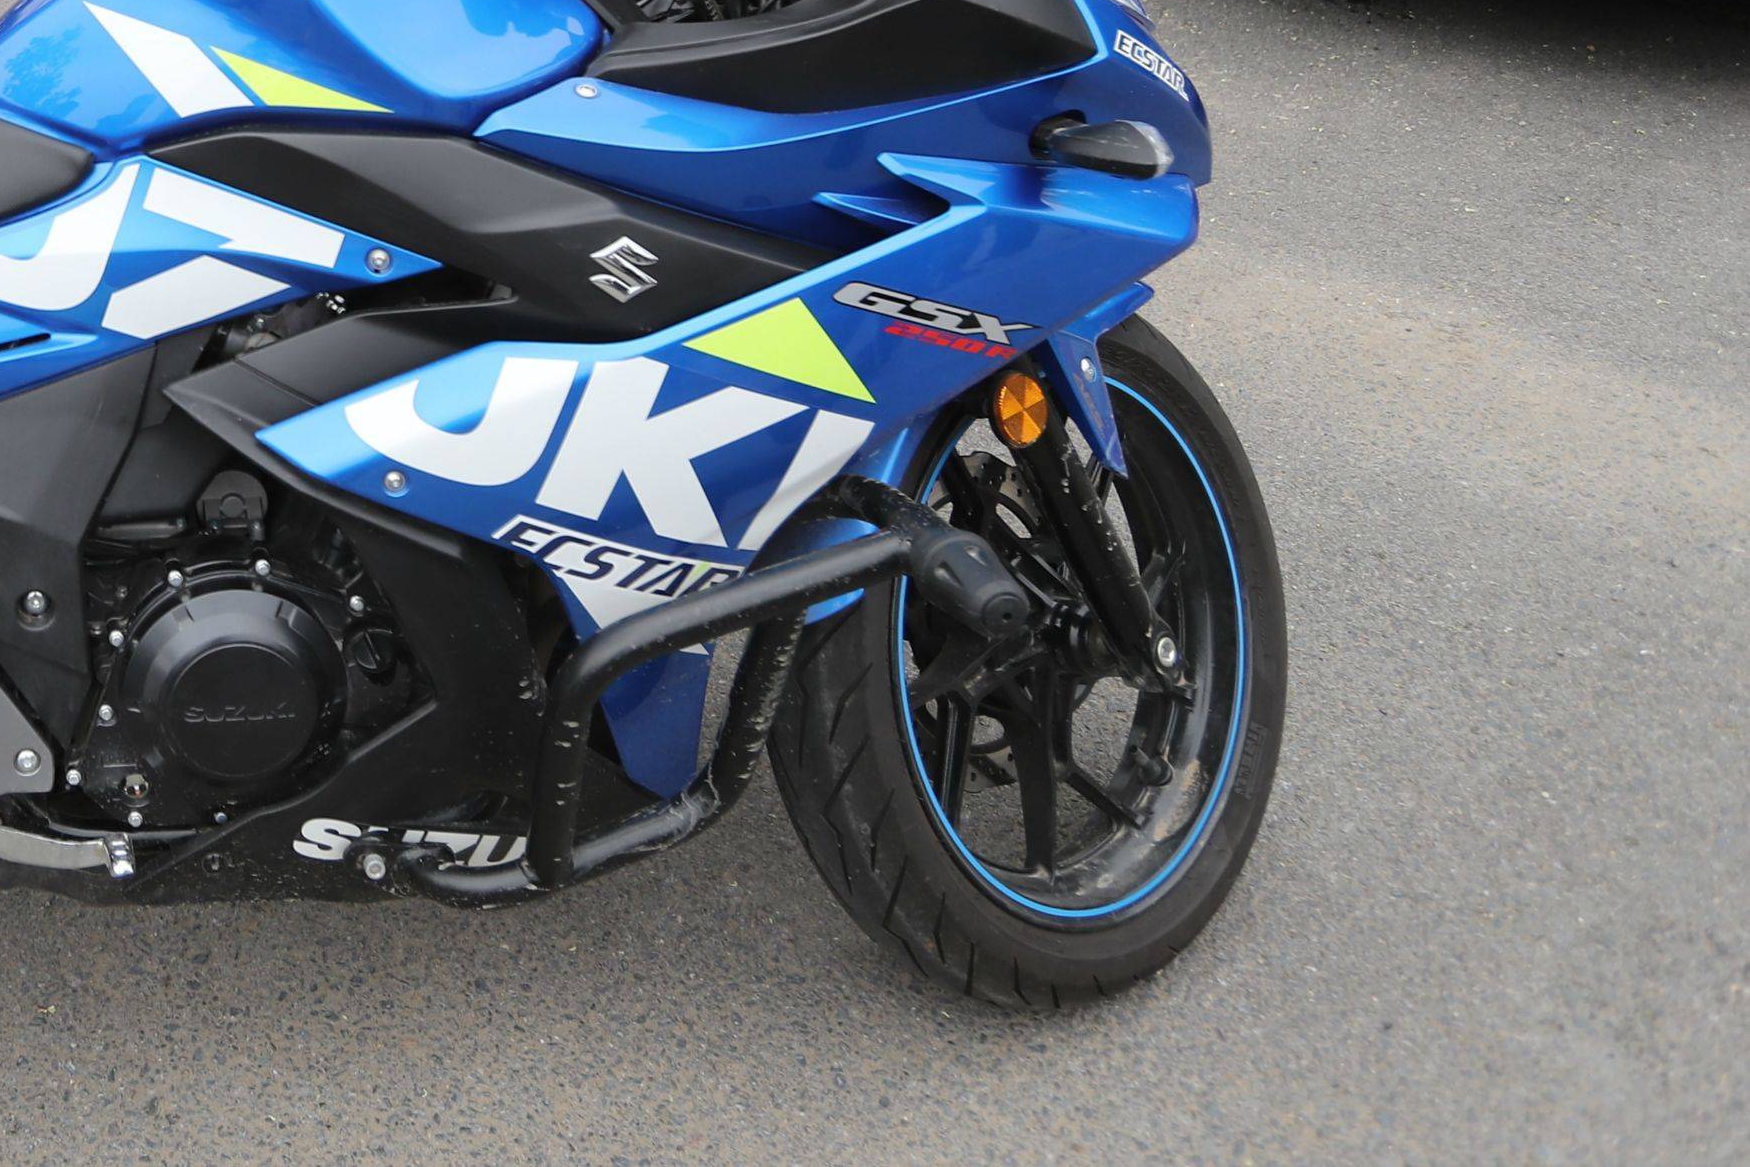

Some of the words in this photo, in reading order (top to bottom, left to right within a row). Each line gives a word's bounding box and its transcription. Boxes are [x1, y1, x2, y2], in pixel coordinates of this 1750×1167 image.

[1115, 31, 1189, 101] ECSTAR
[832, 281, 1042, 346] GSX
[883, 321, 1018, 360] 250R
[183, 702, 297, 723] SUZUKI
